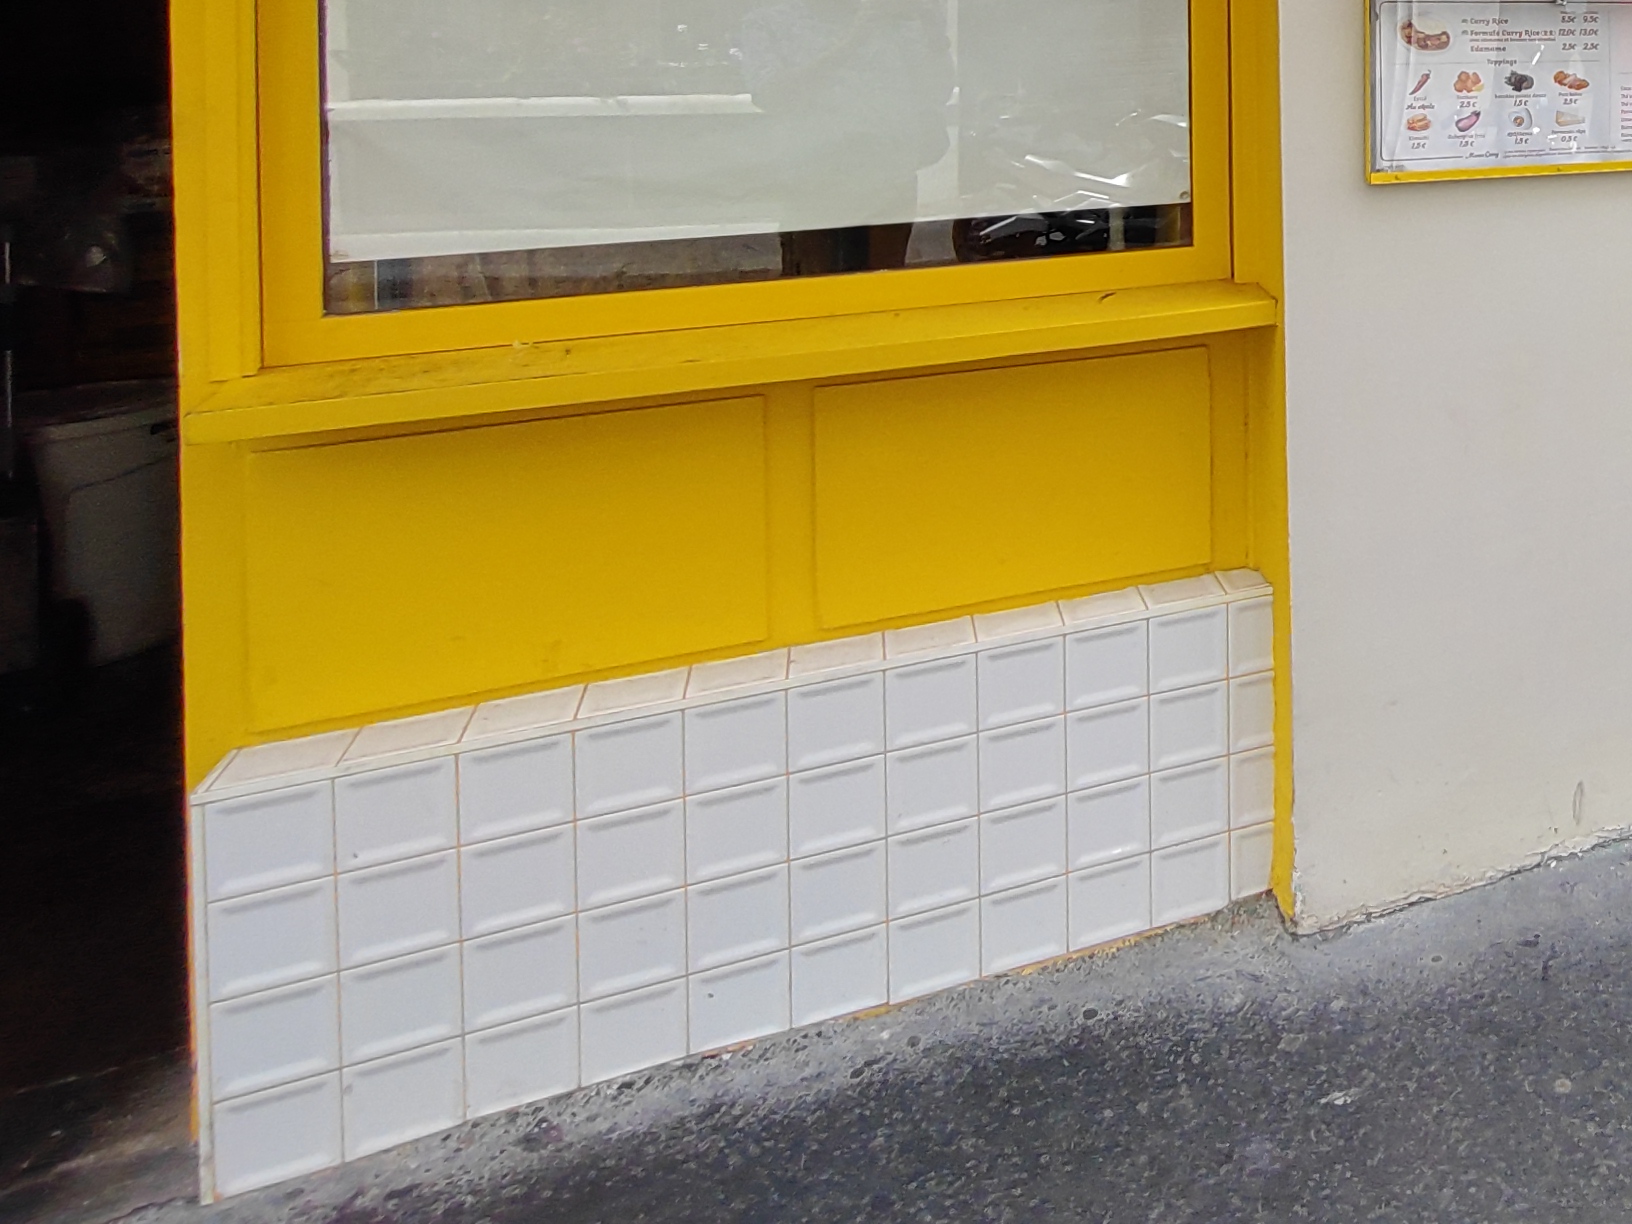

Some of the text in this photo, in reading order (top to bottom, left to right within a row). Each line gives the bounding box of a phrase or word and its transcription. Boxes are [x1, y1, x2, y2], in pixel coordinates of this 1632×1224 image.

[1470, 17, 1490, 26] Curry
[1491, 17, 1509, 26] Rice
[1501, 29, 1523, 38] Curry
[1470, 45, 1507, 53] Edamame
